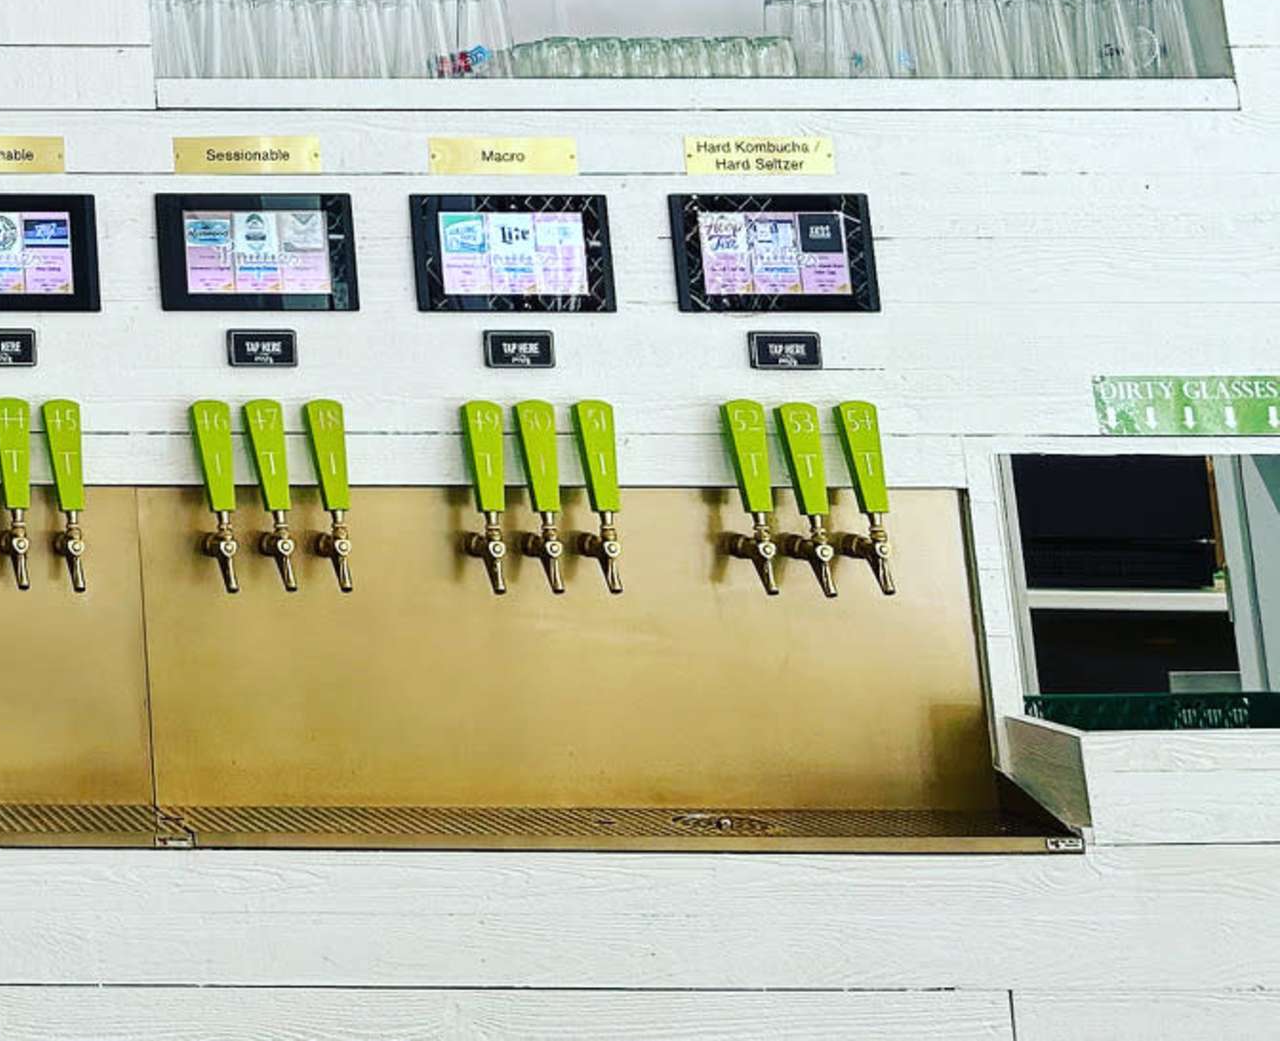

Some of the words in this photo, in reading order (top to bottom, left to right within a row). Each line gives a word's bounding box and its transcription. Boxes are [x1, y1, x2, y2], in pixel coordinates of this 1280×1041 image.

[696, 140, 731, 153] Hard
[735, 140, 810, 153] Kombucha
[206, 148, 290, 161] Sessionable
[481, 150, 525, 162] Macro
[716, 157, 750, 171] Hard
[755, 157, 805, 171] Seltzer
[1, 341, 20, 351] HERE
[1101, 380, 1174, 400] DIRTY
[1183, 380, 1278, 400] GLASSES
[788, 411, 815, 433] 53
